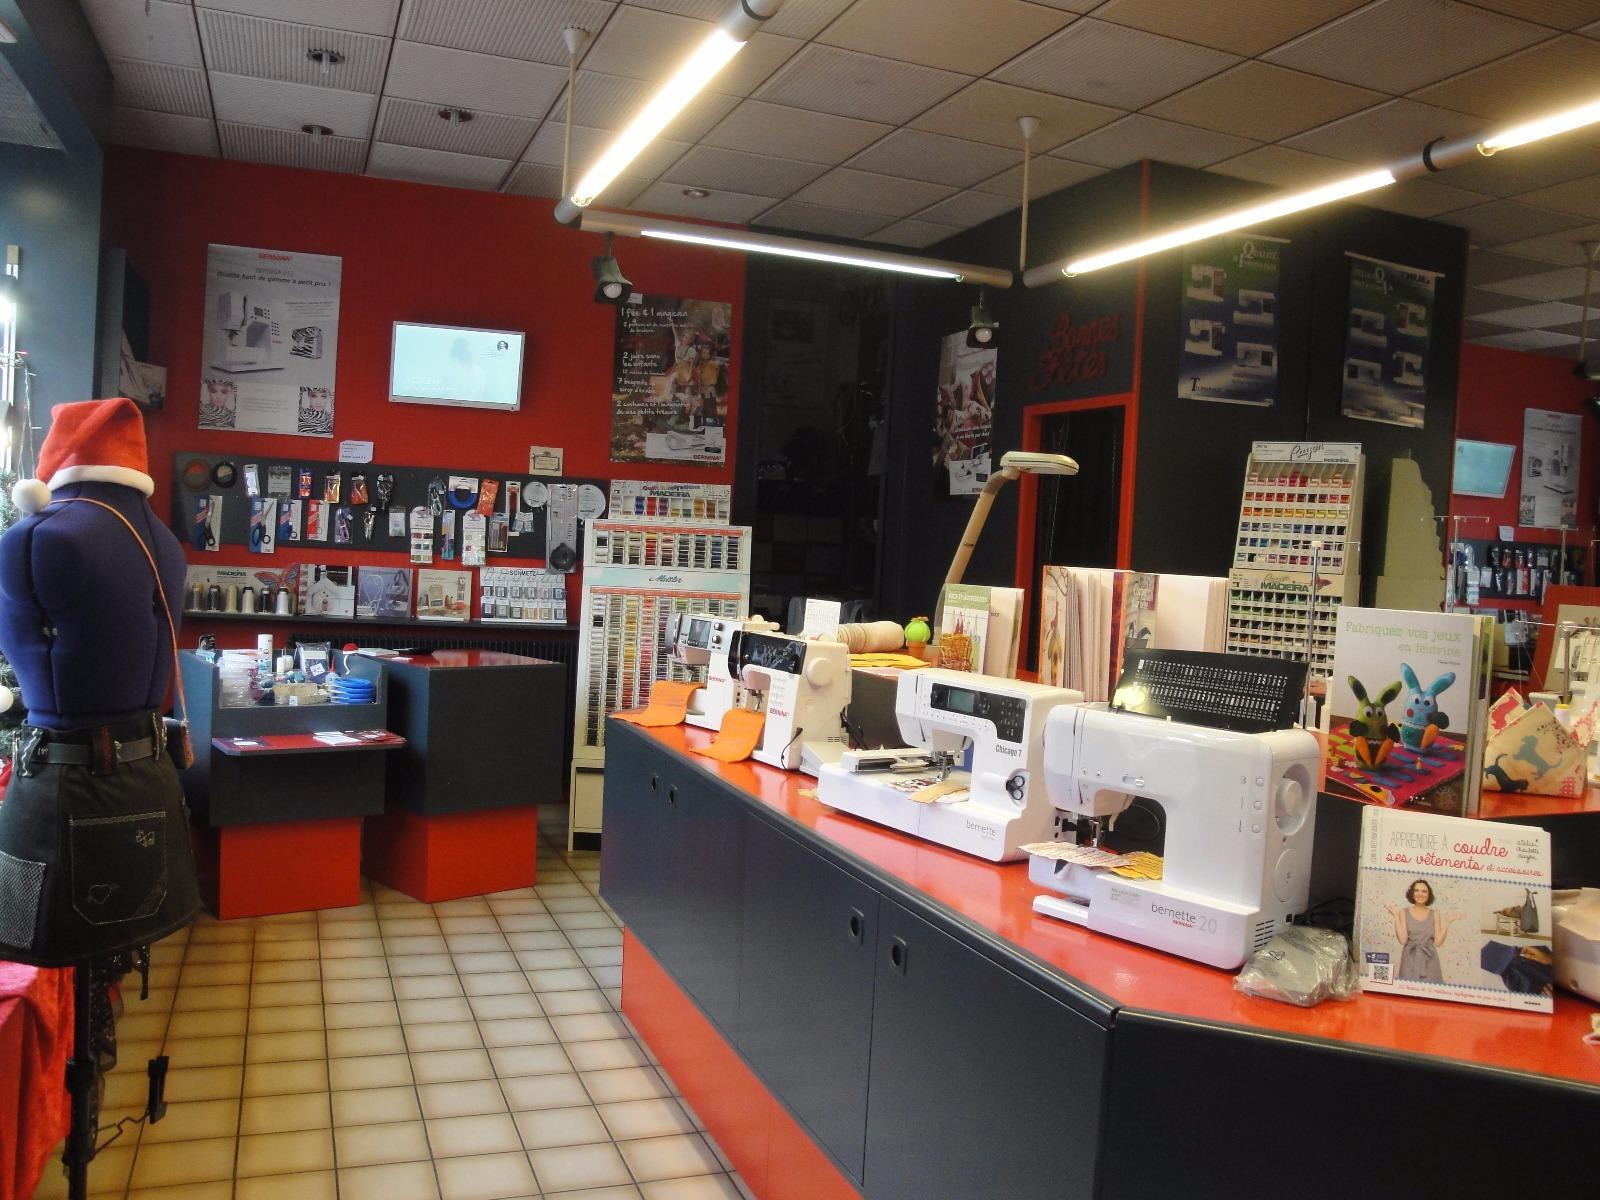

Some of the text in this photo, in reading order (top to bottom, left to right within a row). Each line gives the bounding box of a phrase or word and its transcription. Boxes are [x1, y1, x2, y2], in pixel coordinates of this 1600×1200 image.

[650, 490, 691, 498] MADEIRA
[1261, 582, 1309, 592] MADEIRA
[1345, 621, 1464, 642] Fabriquez vos jeux
[1398, 643, 1461, 656] en feutrine
[770, 707, 789, 718] BERNINA
[995, 744, 1022, 757] Chicago 7
[966, 819, 996, 837] bernette
[1390, 831, 1438, 850] APPRENDRE
[1453, 837, 1509, 857] coudre
[1386, 852, 1411, 863] ses
[1416, 853, 1484, 870] vêtements
[1496, 867, 1543, 877] accessoires
[1151, 901, 1217, 934] bernette 20
